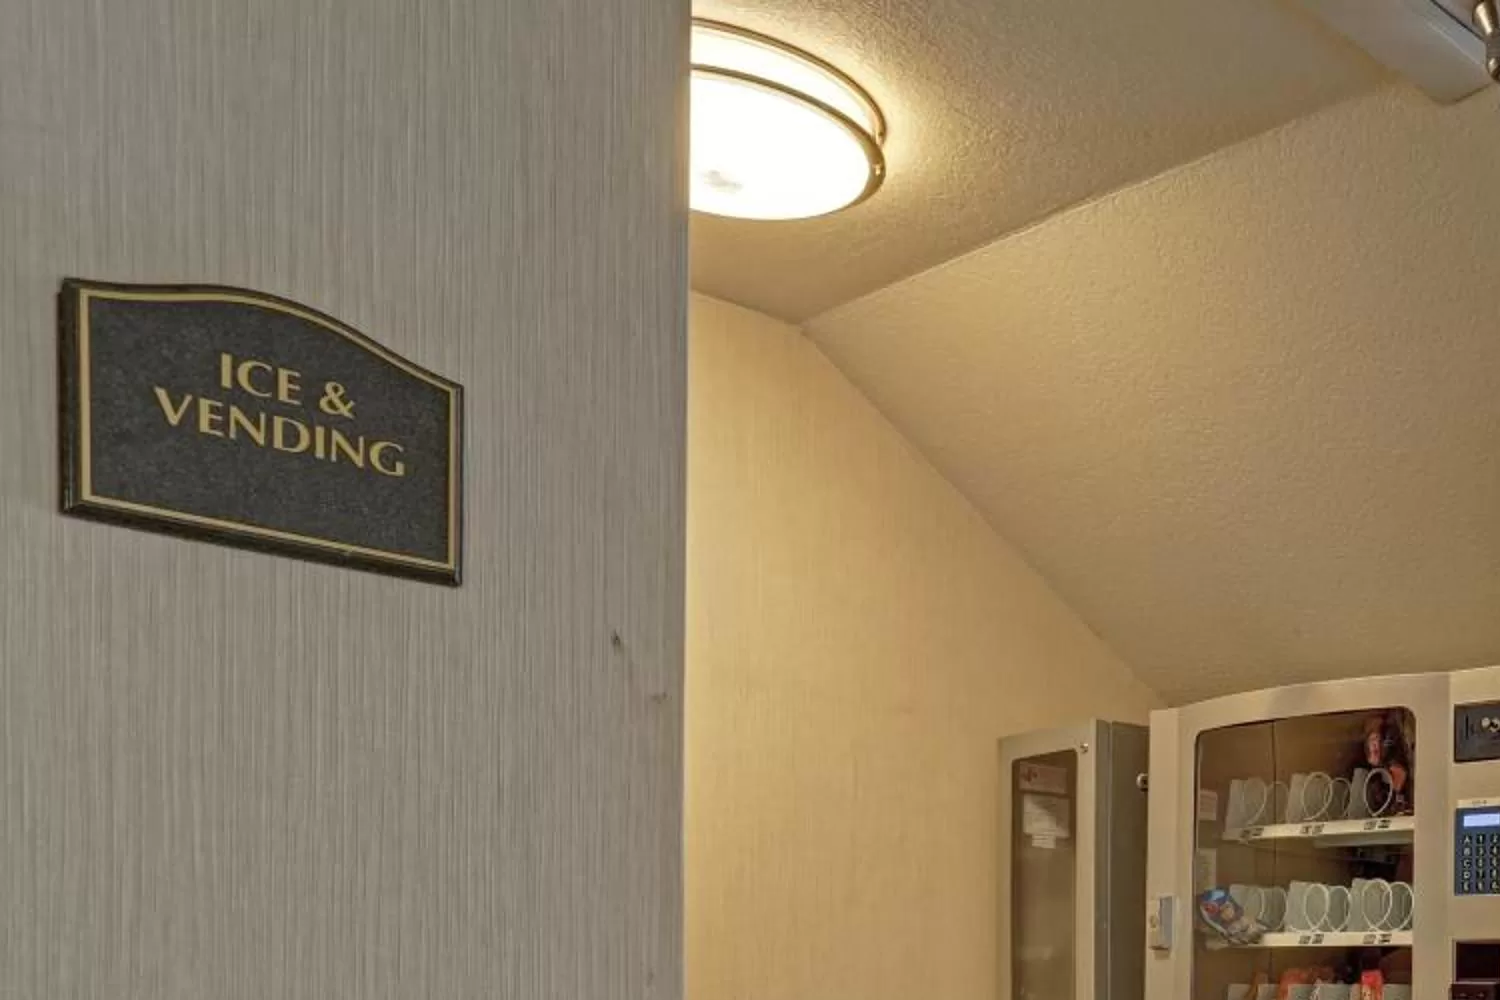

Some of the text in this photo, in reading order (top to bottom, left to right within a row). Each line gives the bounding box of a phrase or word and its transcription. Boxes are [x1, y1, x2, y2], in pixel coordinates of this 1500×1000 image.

[220, 352, 356, 420] ICE &
[153, 385, 406, 477] VENDING
